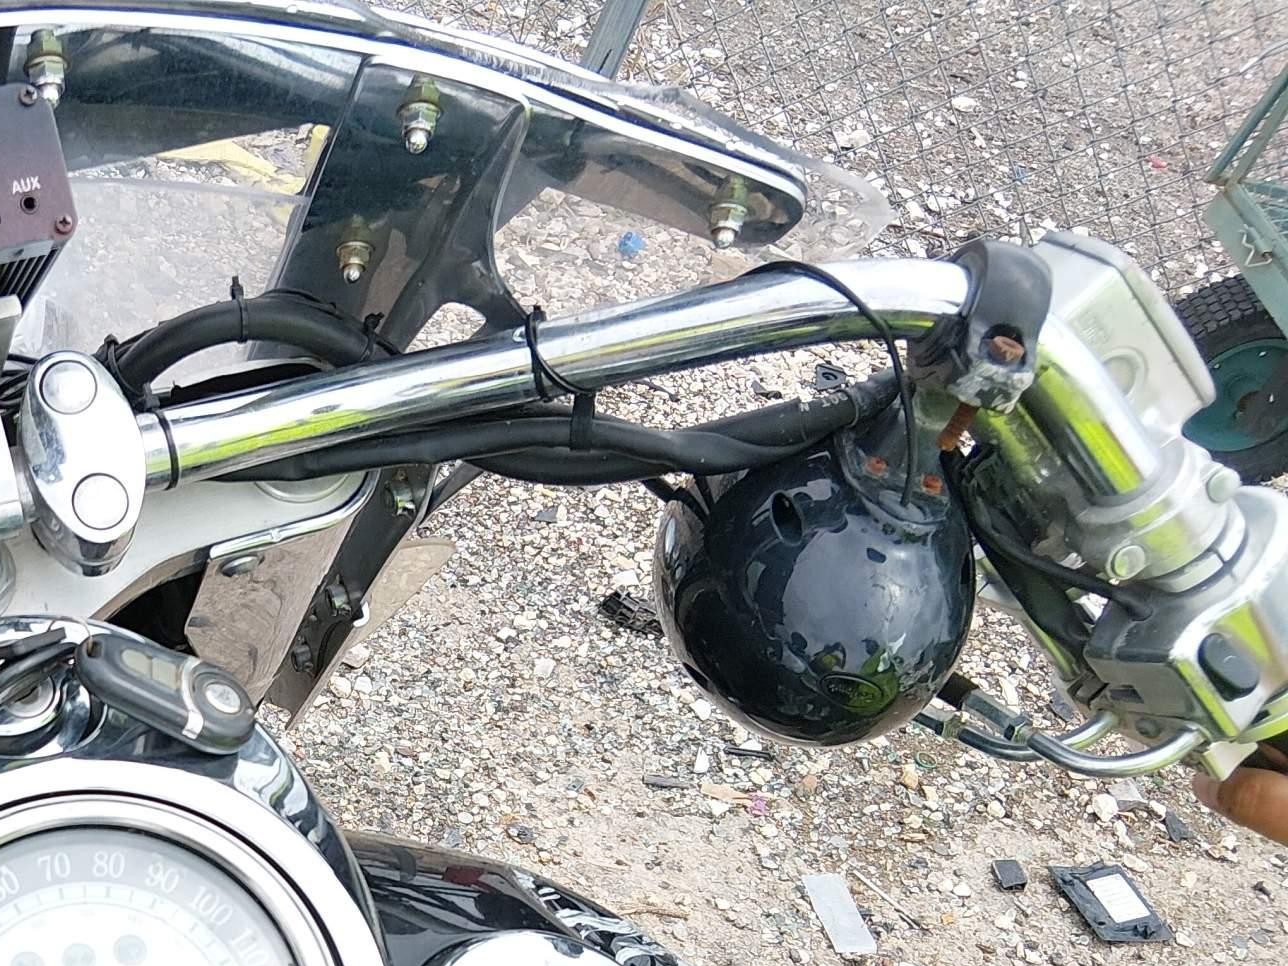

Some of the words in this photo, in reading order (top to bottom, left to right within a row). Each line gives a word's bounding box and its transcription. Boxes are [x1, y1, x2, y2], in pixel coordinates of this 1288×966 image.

[12, 176, 41, 195] AUX
[37, 852, 71, 881] 70
[92, 851, 125, 878] 80
[145, 861, 180, 893] 90
[188, 885, 234, 926] 100
